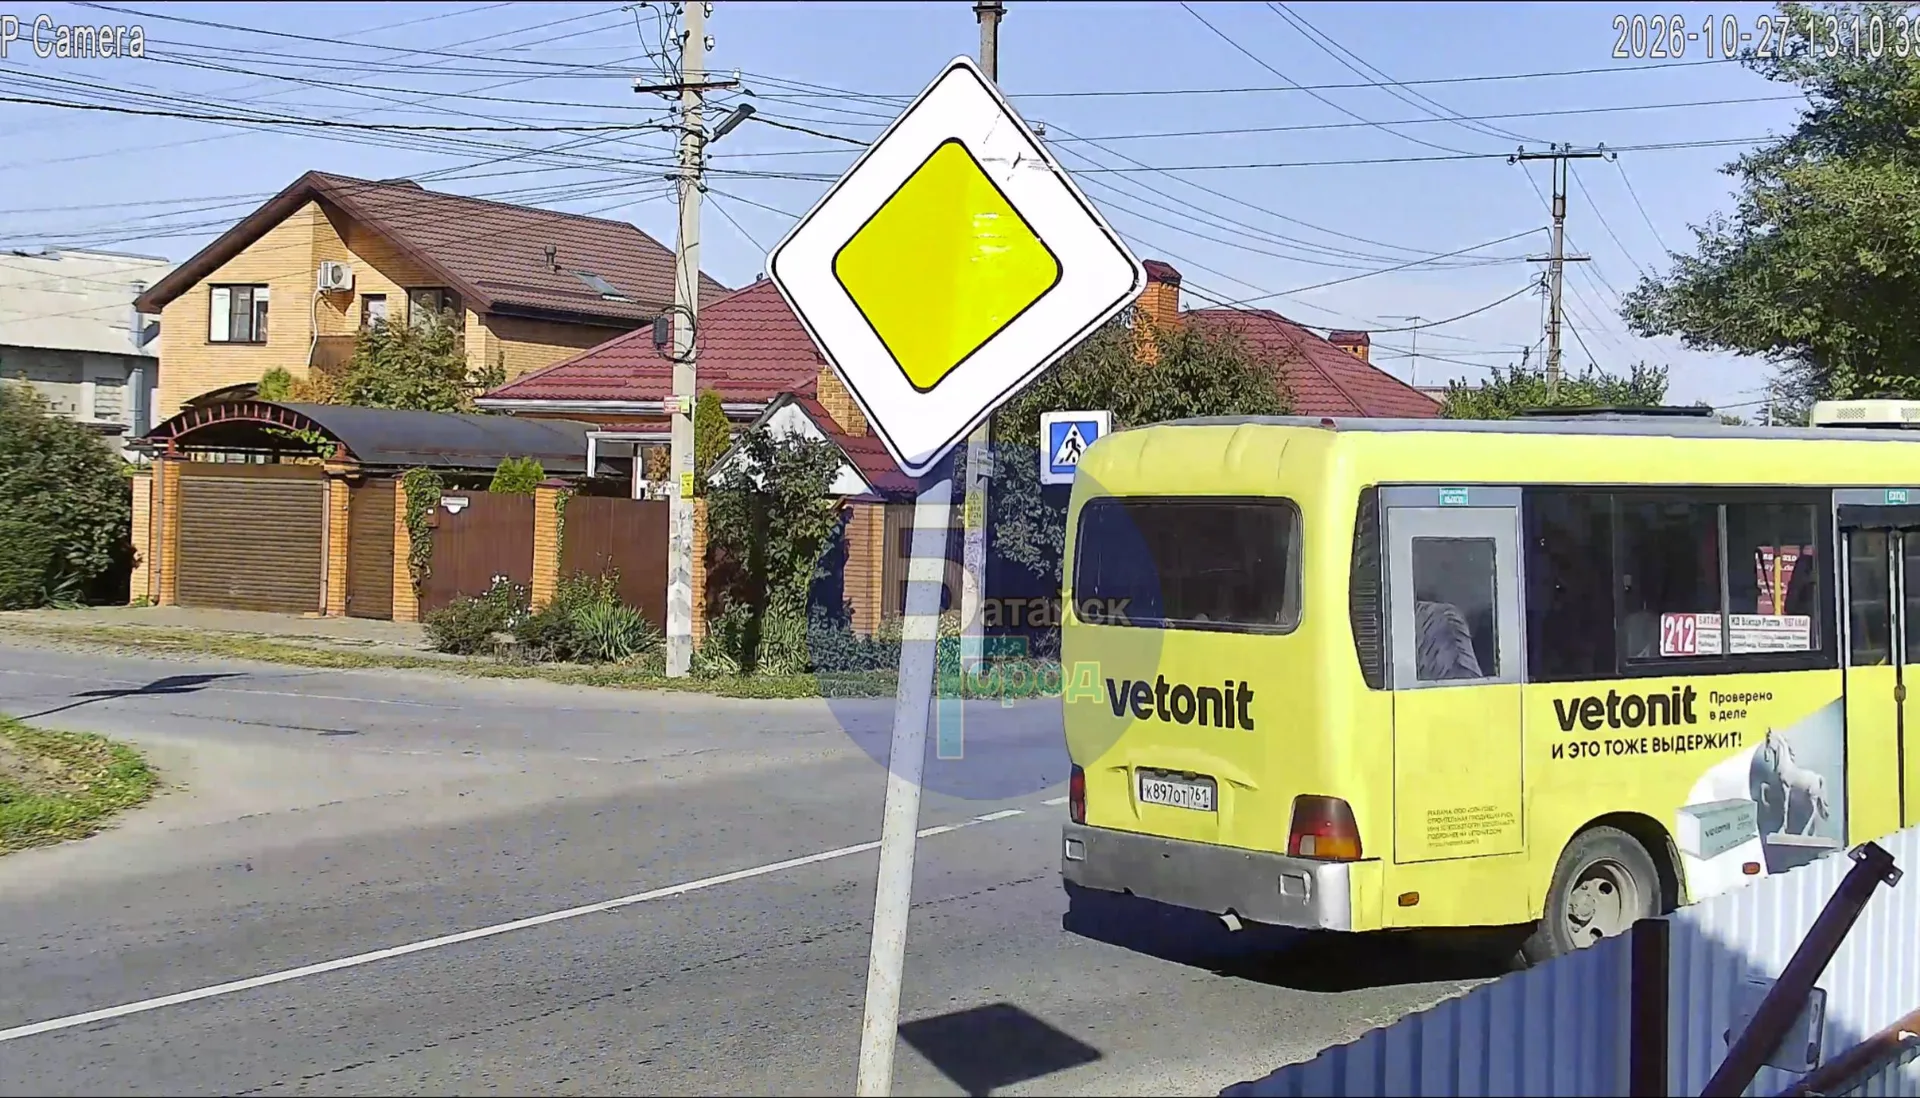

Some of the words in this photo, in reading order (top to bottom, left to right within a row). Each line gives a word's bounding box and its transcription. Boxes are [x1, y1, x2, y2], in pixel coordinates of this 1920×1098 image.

[1665, 614, 1695, 653] 212
[1106, 674, 1254, 731] vetonit
[1553, 685, 1697, 732] vetonit
[1709, 691, 1773, 707] Проверено
[1709, 710, 1716, 720] в
[1718, 709, 1747, 722] деле
[1552, 743, 1564, 759] И
[1568, 741, 1601, 759] ЭТО
[1605, 738, 1648, 756] ТОЖЕ
[1652, 731, 1742, 753] ВЫДЕРЖИТ!
